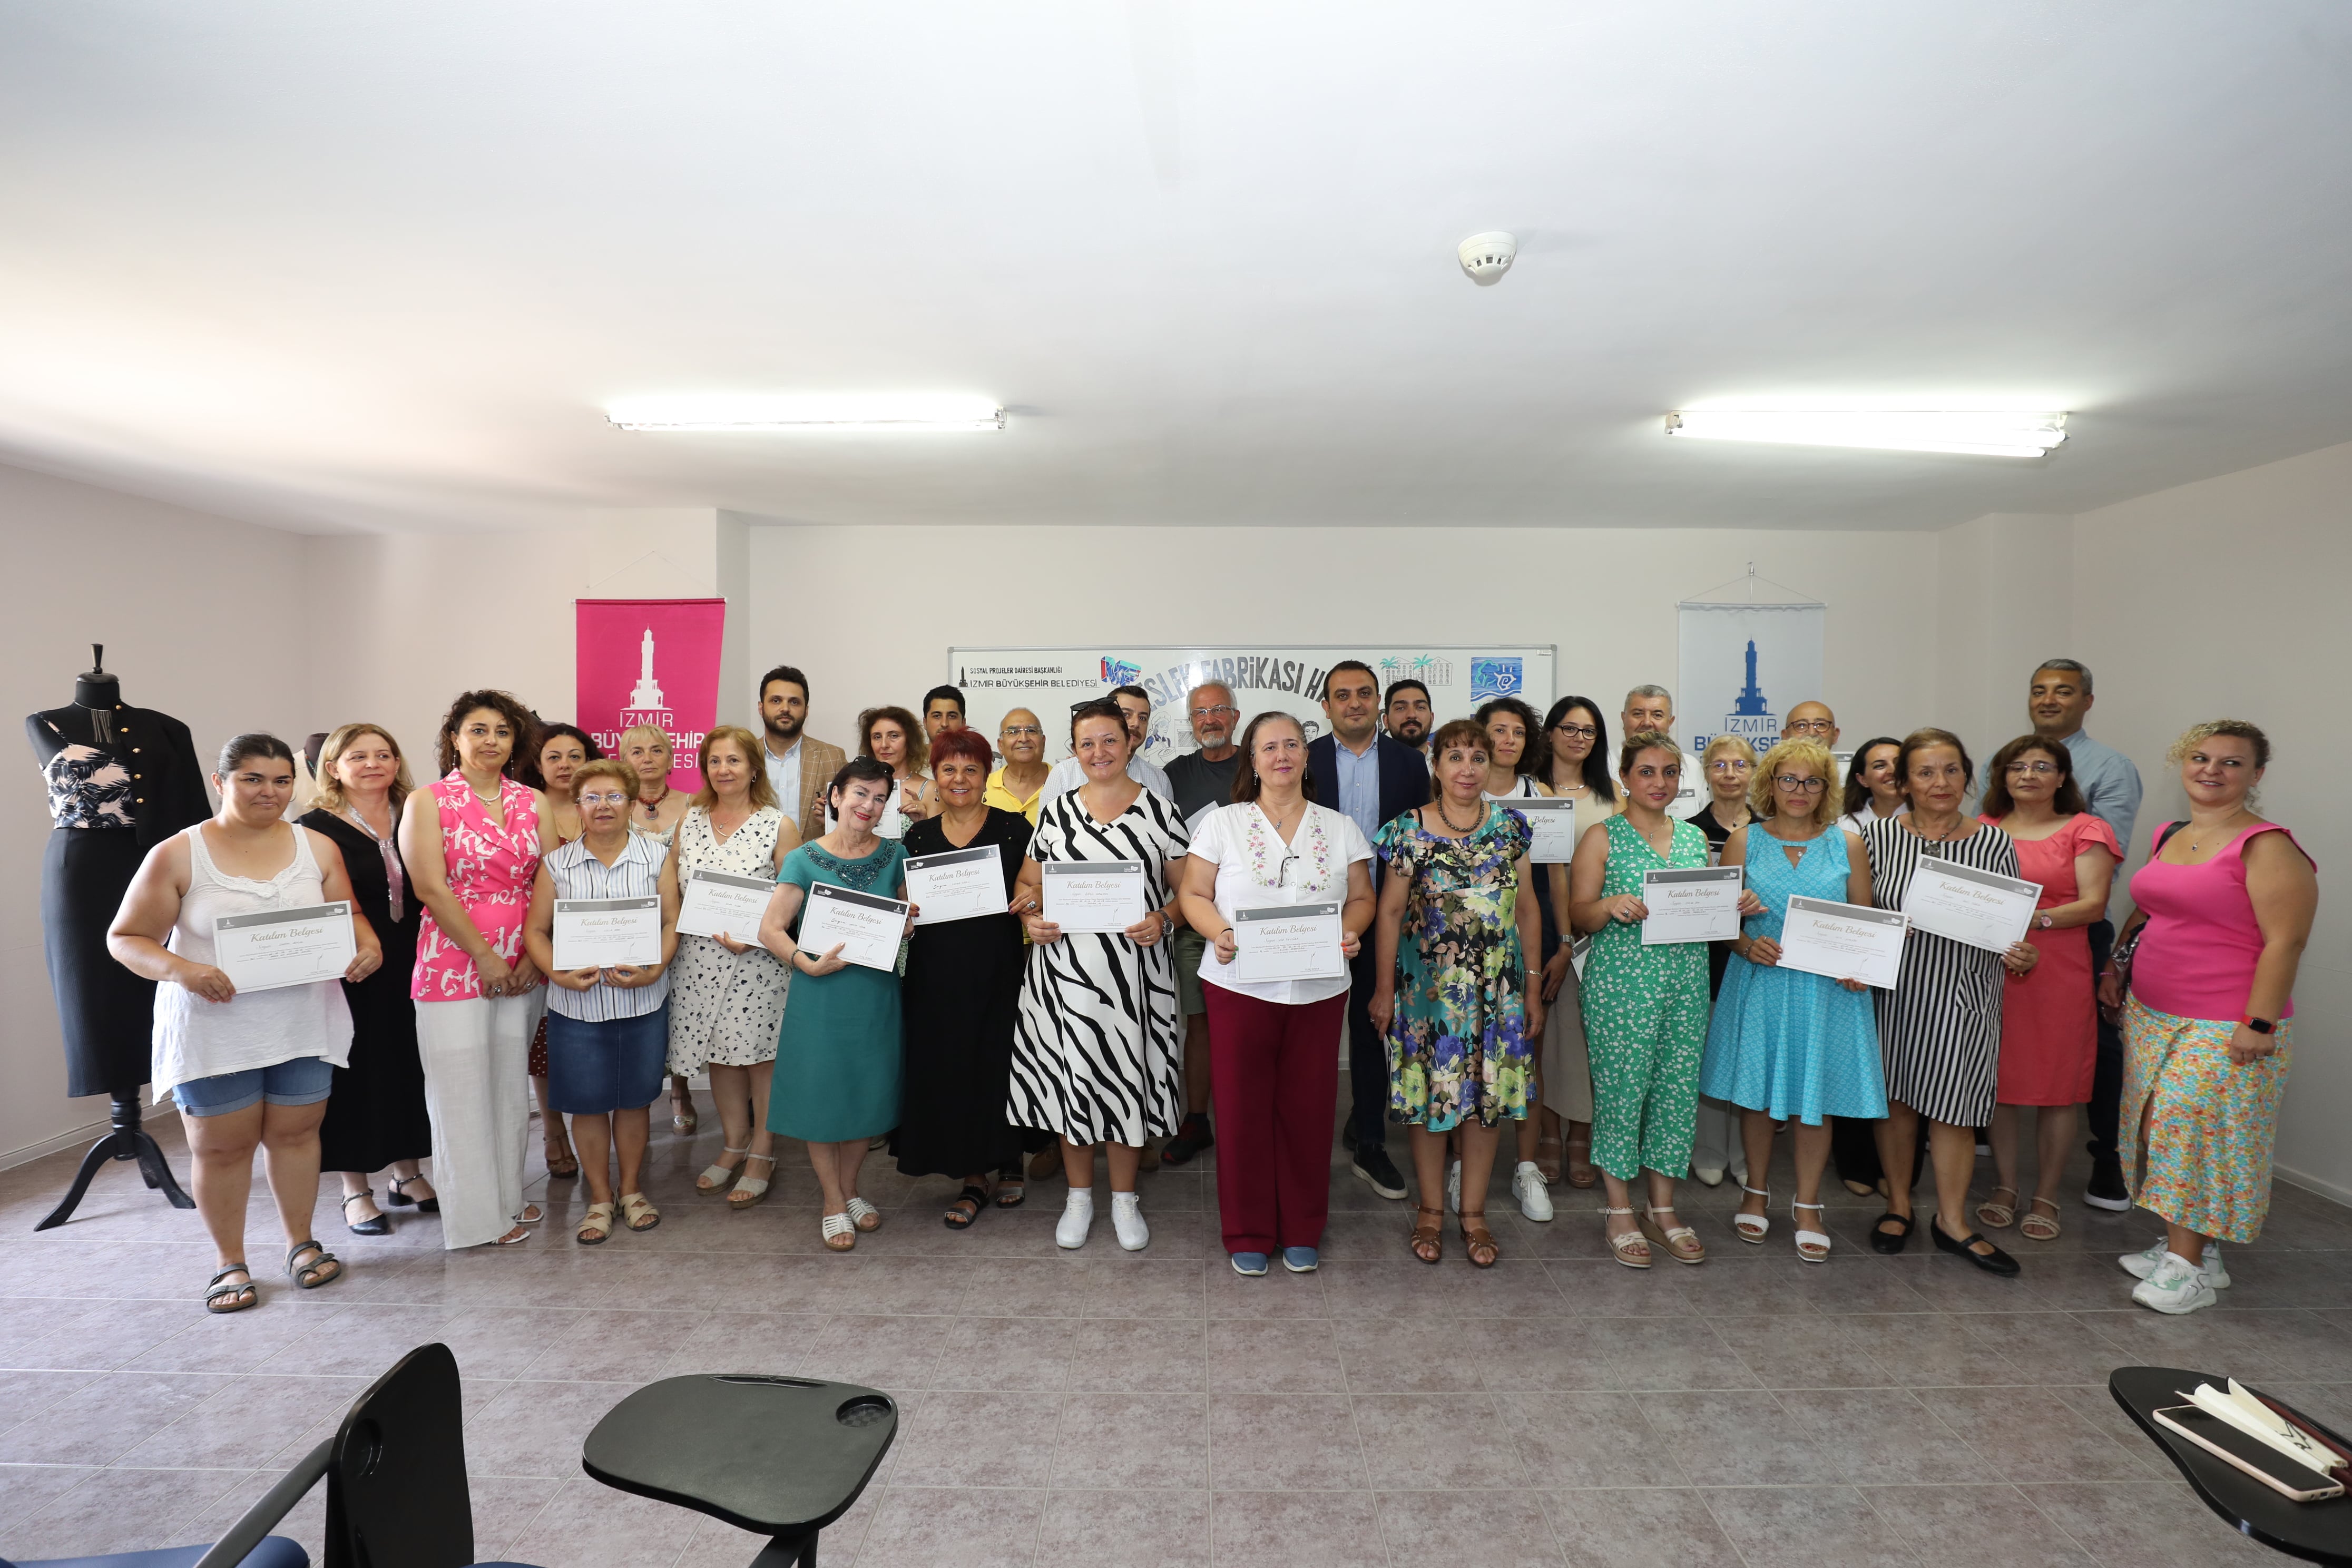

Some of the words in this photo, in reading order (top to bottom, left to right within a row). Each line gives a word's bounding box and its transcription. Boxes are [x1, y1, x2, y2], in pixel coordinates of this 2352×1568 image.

[1034, 666, 1062, 674] BAŞKANLIĞI
[970, 679, 994, 688] İZMİR
[996, 679, 1048, 689] BÜYÜKŞEHİR
[1051, 679, 1097, 687] BELEDİYESİ
[620, 711, 673, 728] İZMİR
[1725, 717, 1777, 732] İZMİR
[1534, 815, 1556, 825] Belgesi
[928, 872, 954, 882] Katılım
[956, 868, 980, 878] Belgesi
[1095, 880, 1121, 890] Belgesi
[708, 889, 732, 899] Katılım
[734, 893, 759, 904] Belgesi
[1668, 889, 1693, 898] Katılım
[1695, 888, 1720, 898] Belgesi
[1939, 881, 1971, 896] Katılım
[1973, 890, 2006, 905] Belgesi
[581, 918, 609, 926] Katılım
[611, 917, 638, 926] Belgesi
[830, 906, 856, 919] Katılım
[857, 912, 884, 924] Belgesi
[250, 930, 287, 943] Katılım
[289, 926, 324, 938] Belgesi
[1260, 926, 1288, 935] Katılım
[1290, 924, 1317, 934] Belgesi
[1812, 919, 1843, 932] Katılım
[1845, 925, 1876, 938] Belgesi
